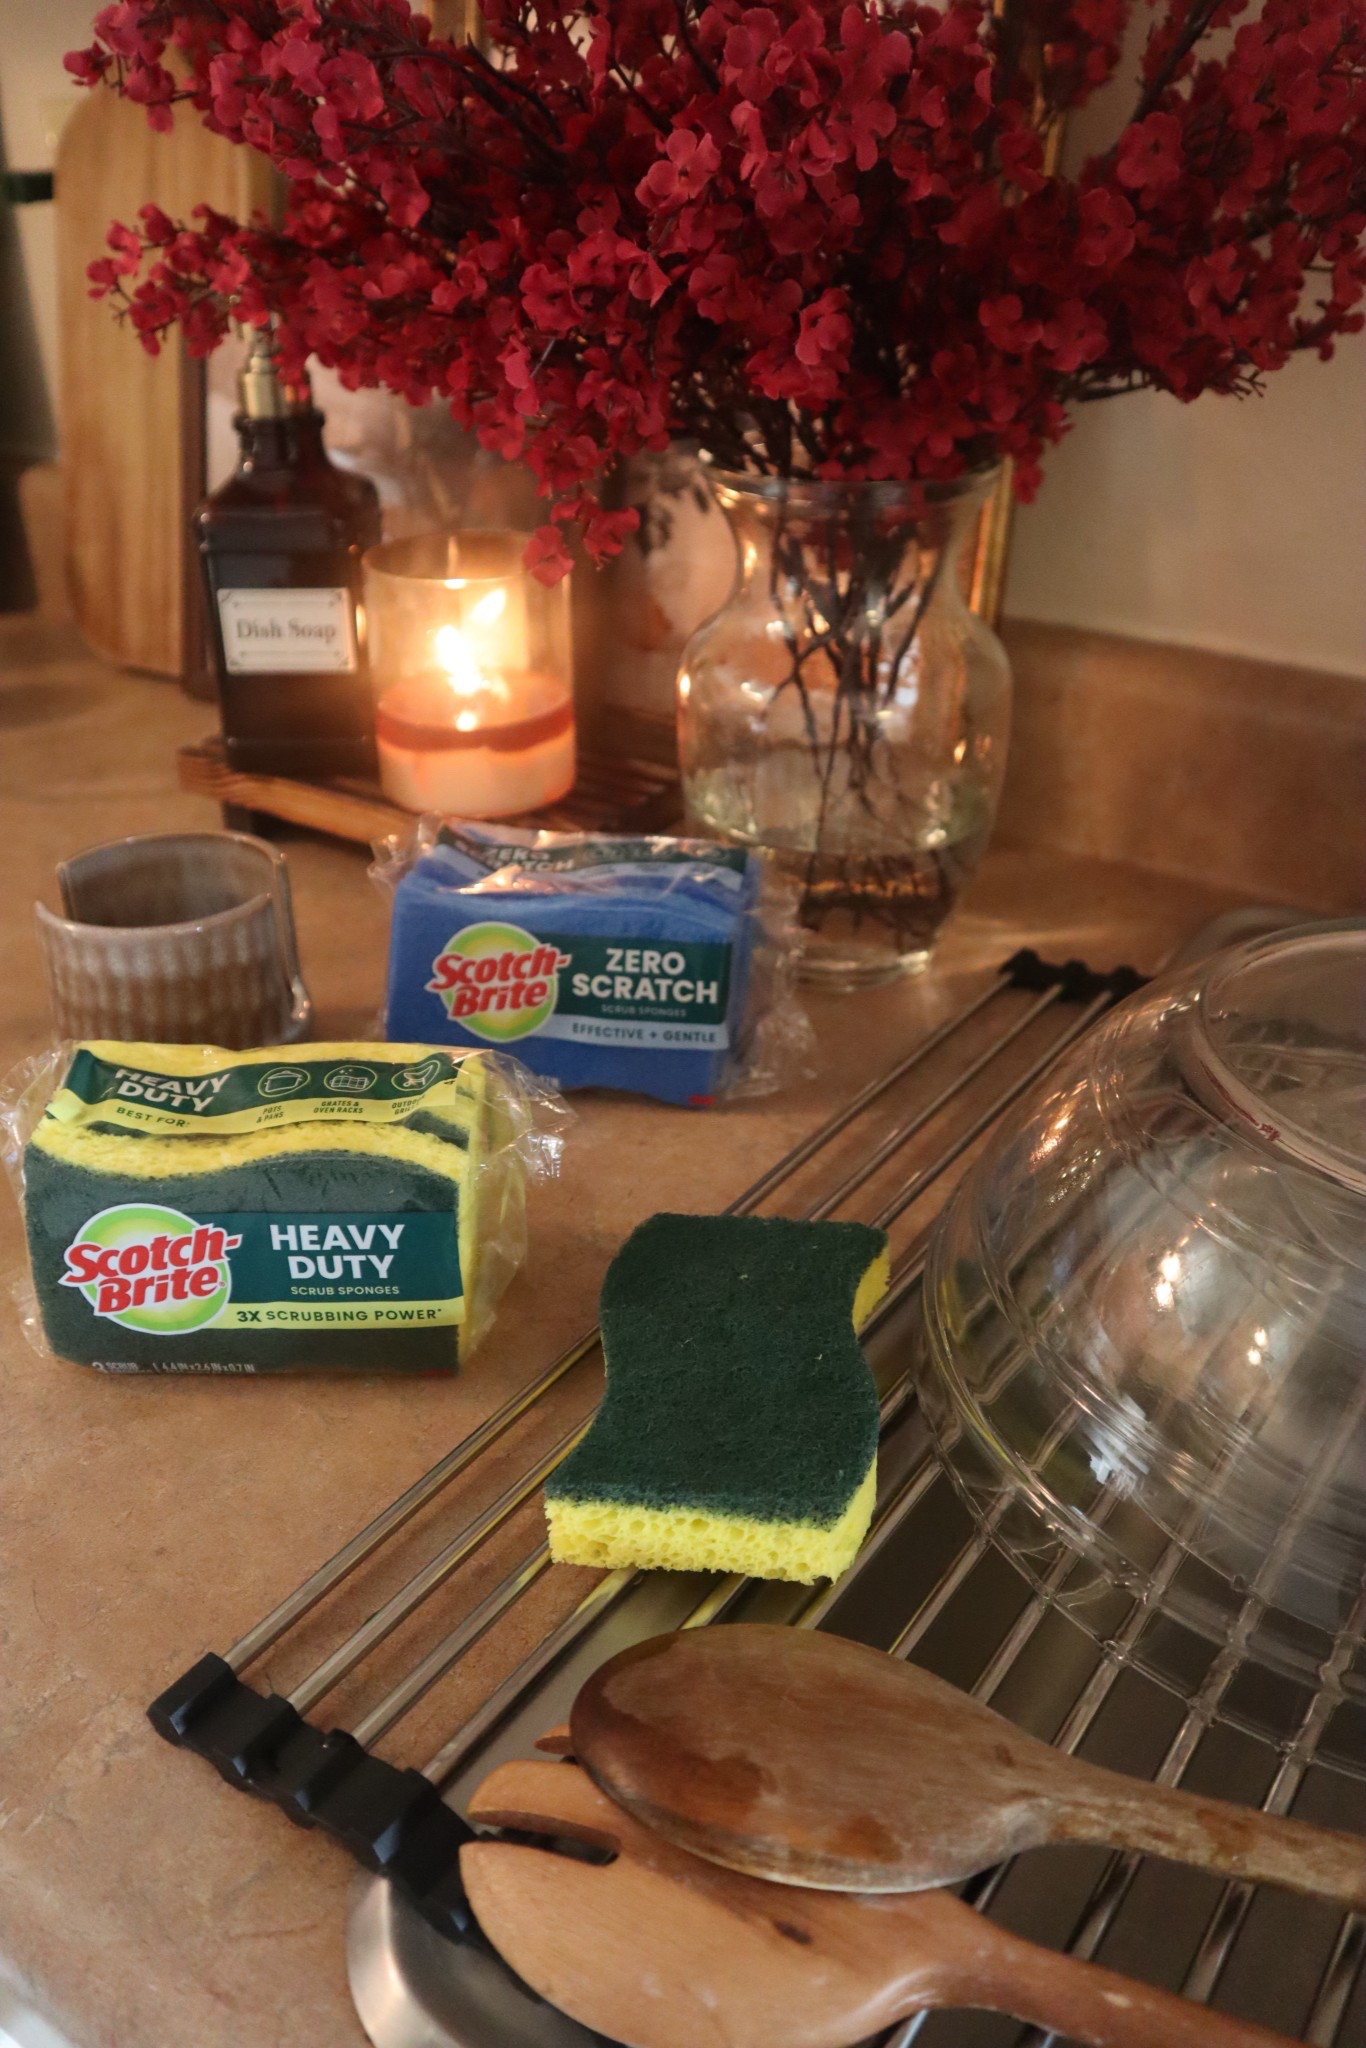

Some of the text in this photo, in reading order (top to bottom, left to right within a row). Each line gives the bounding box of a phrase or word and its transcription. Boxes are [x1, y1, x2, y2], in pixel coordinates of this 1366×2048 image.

[236, 617, 337, 645] Dish Soap
[606, 947, 686, 975] ZERO
[451, 981, 548, 1018] Brite
[572, 973, 718, 1004] SCRATCH
[601, 1003, 687, 1017] SCRUB SPONGES
[572, 1022, 644, 1040] EFFECTIVE
[663, 1030, 716, 1043] GENTLE
[114, 1068, 231, 1097] HEAVY
[116, 1080, 215, 1112] DUTY
[116, 1106, 153, 1121] BEST
[263, 1105, 282, 1114] POTS
[264, 1112, 284, 1121] PANS
[270, 1224, 405, 1251] HEAVY
[65, 1227, 239, 1283] Scotch-
[287, 1254, 395, 1279] DUTY
[97, 1266, 219, 1313] Brite
[290, 1286, 400, 1296] SCRUB SPONGES
[236, 1310, 262, 1322] 3X
[266, 1310, 368, 1322] SCRUBBING
